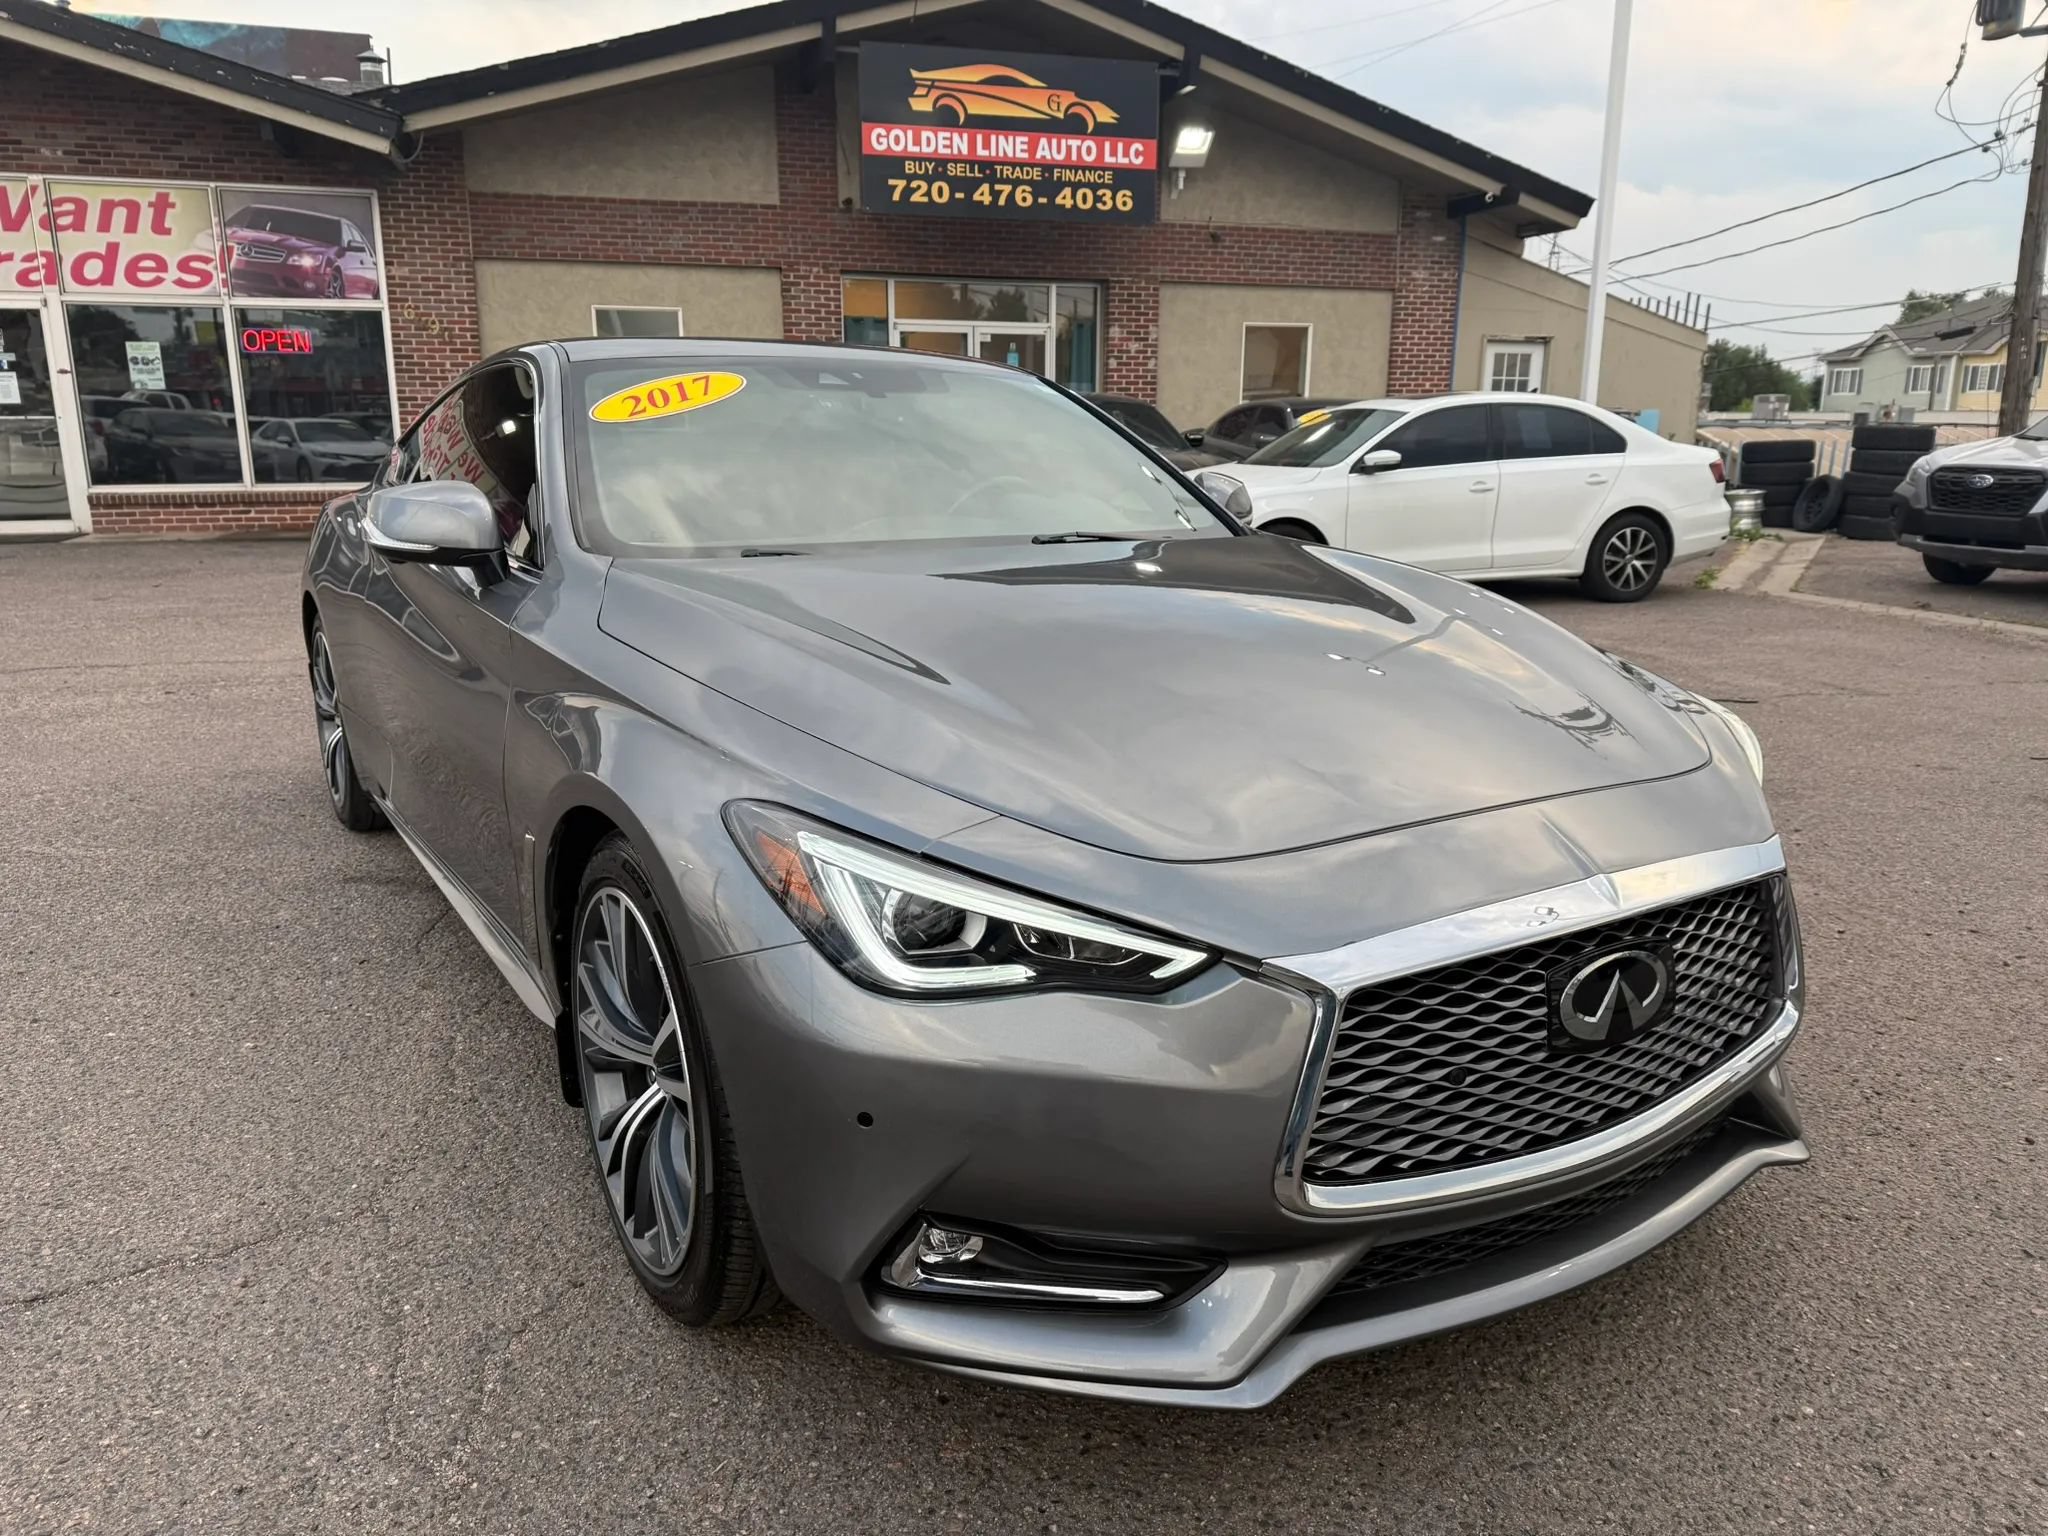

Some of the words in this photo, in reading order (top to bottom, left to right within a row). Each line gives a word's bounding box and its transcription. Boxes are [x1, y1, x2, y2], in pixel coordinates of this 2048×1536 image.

[1047, 94, 1061, 113] G
[870, 127, 968, 155] GOLDEN
[976, 133, 1029, 159] LINE
[1035, 137, 1097, 161] AUTO
[1103, 141, 1144, 165] LLC
[905, 160, 935, 175] BUY
[946, 162, 983, 178] SELL
[994, 165, 1042, 180] TRADE
[1053, 169, 1113, 184] FINANCE
[243, 329, 311, 352] OPEN
[621, 375, 710, 417] 2017
